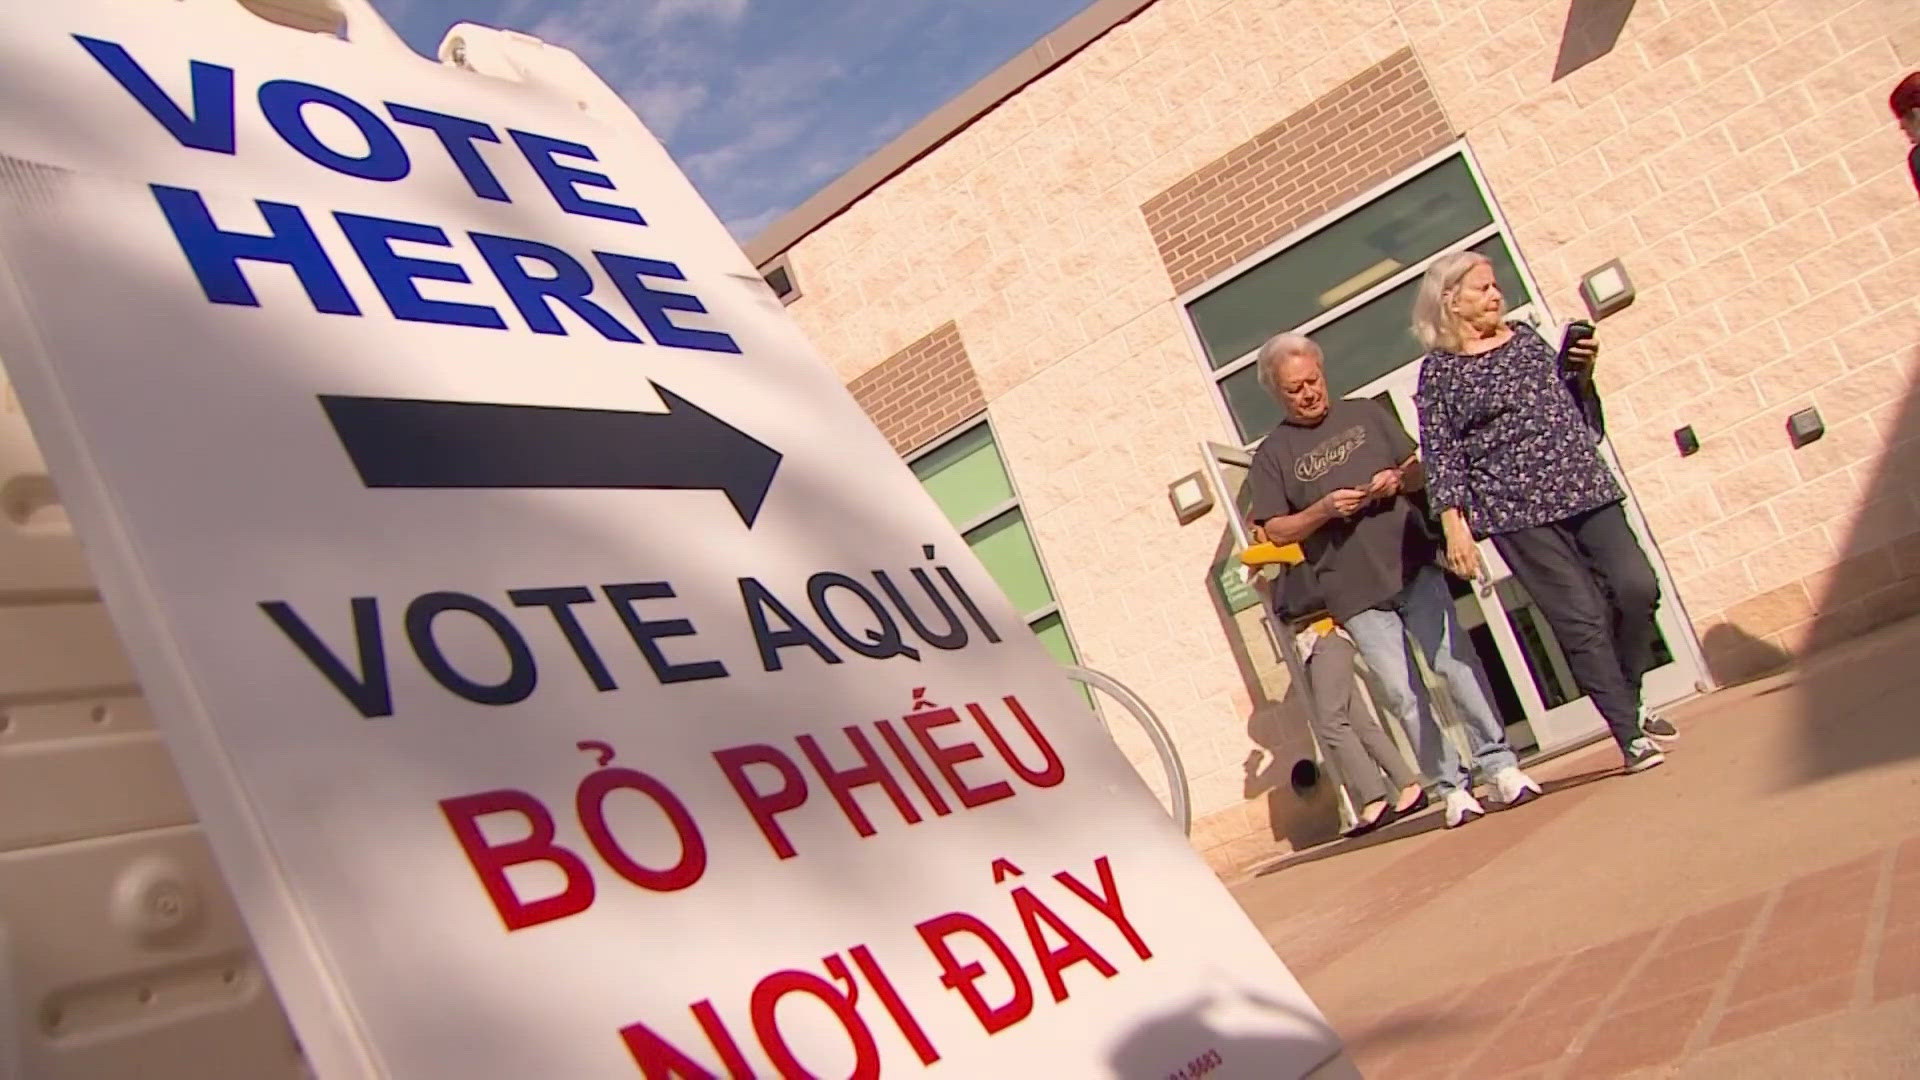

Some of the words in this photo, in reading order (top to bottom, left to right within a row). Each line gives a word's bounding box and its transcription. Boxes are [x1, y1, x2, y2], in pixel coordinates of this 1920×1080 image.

[73, 33, 648, 227] VOTE
[149, 183, 742, 354] HERE
[257, 581, 730, 719] VOTE
[737, 544, 1003, 671] AQUÍ
[439, 740, 708, 932] BỎ
[711, 686, 1066, 860] PHIẾU
[914, 856, 1154, 1037] ĐÂY
